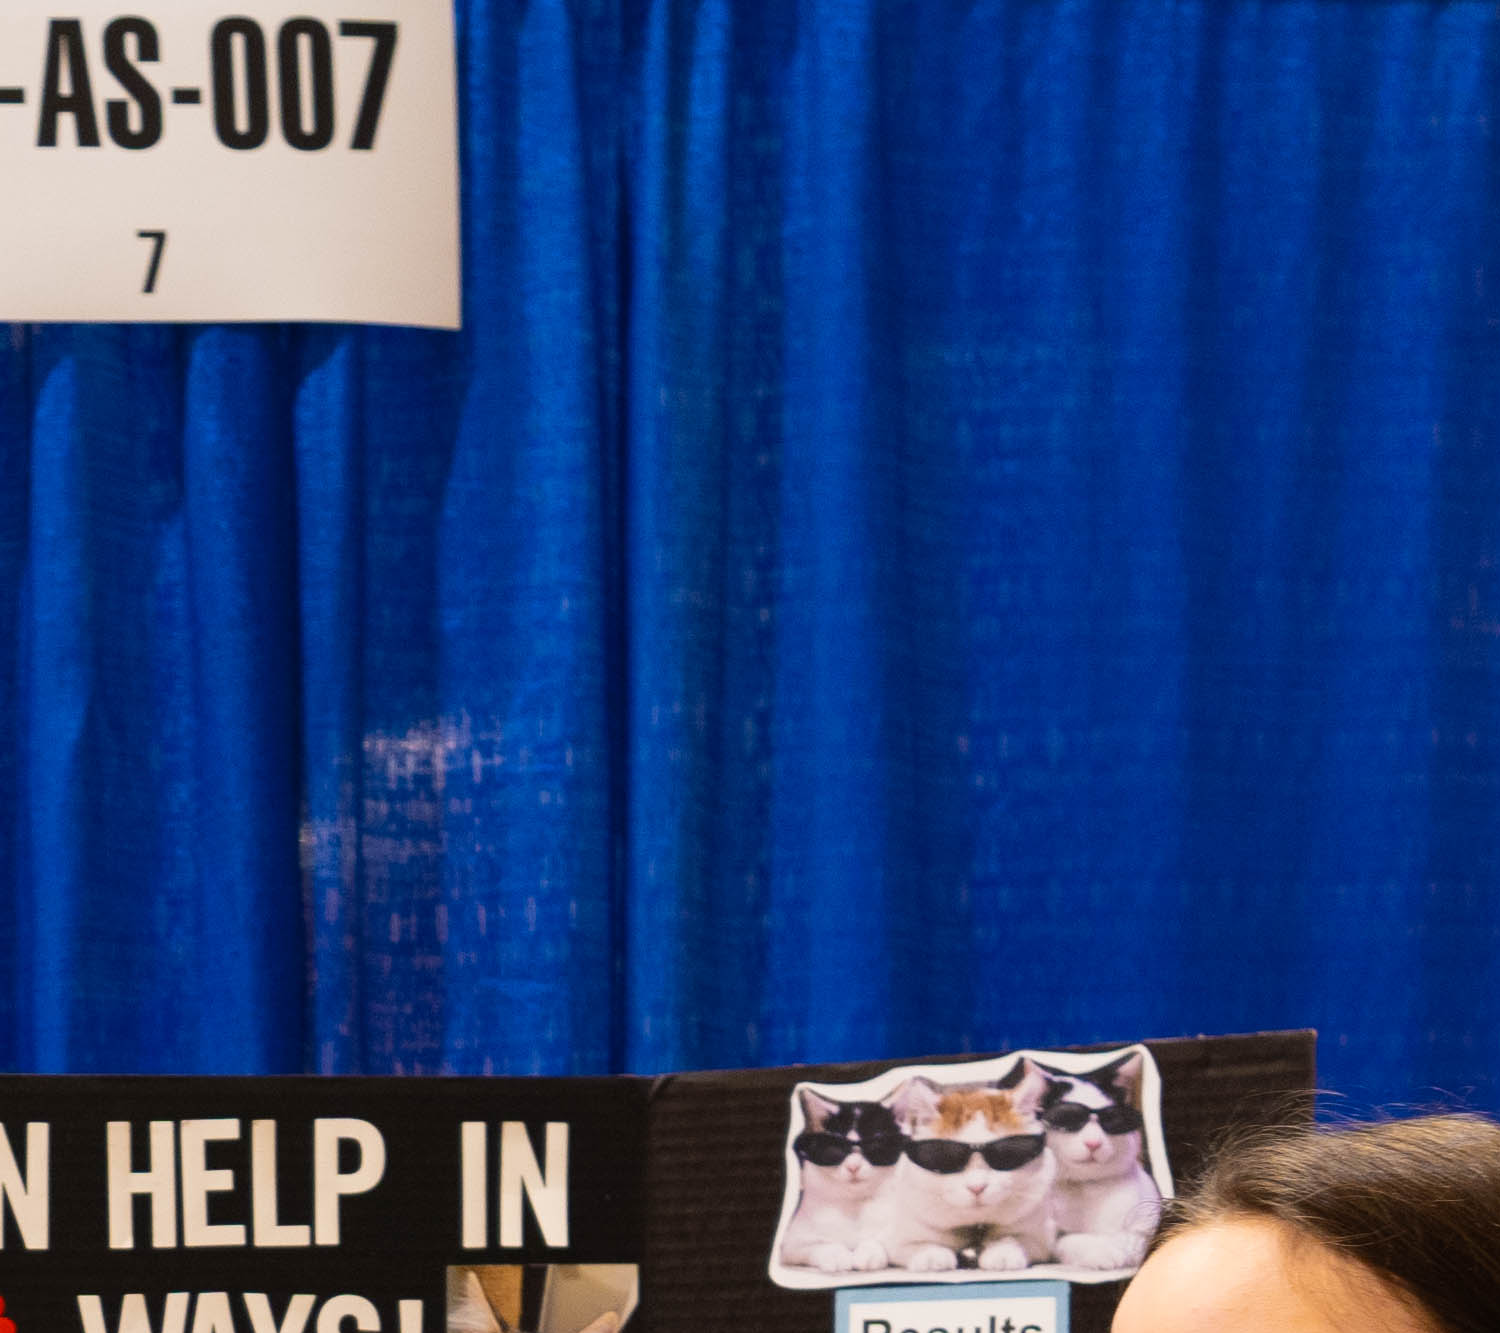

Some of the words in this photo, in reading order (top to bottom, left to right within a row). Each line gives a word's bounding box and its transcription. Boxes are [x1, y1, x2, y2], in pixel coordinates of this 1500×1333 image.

[137, 231, 167, 293] 7
[106, 1118, 387, 1248] HELP
[460, 1120, 570, 1248] IN
